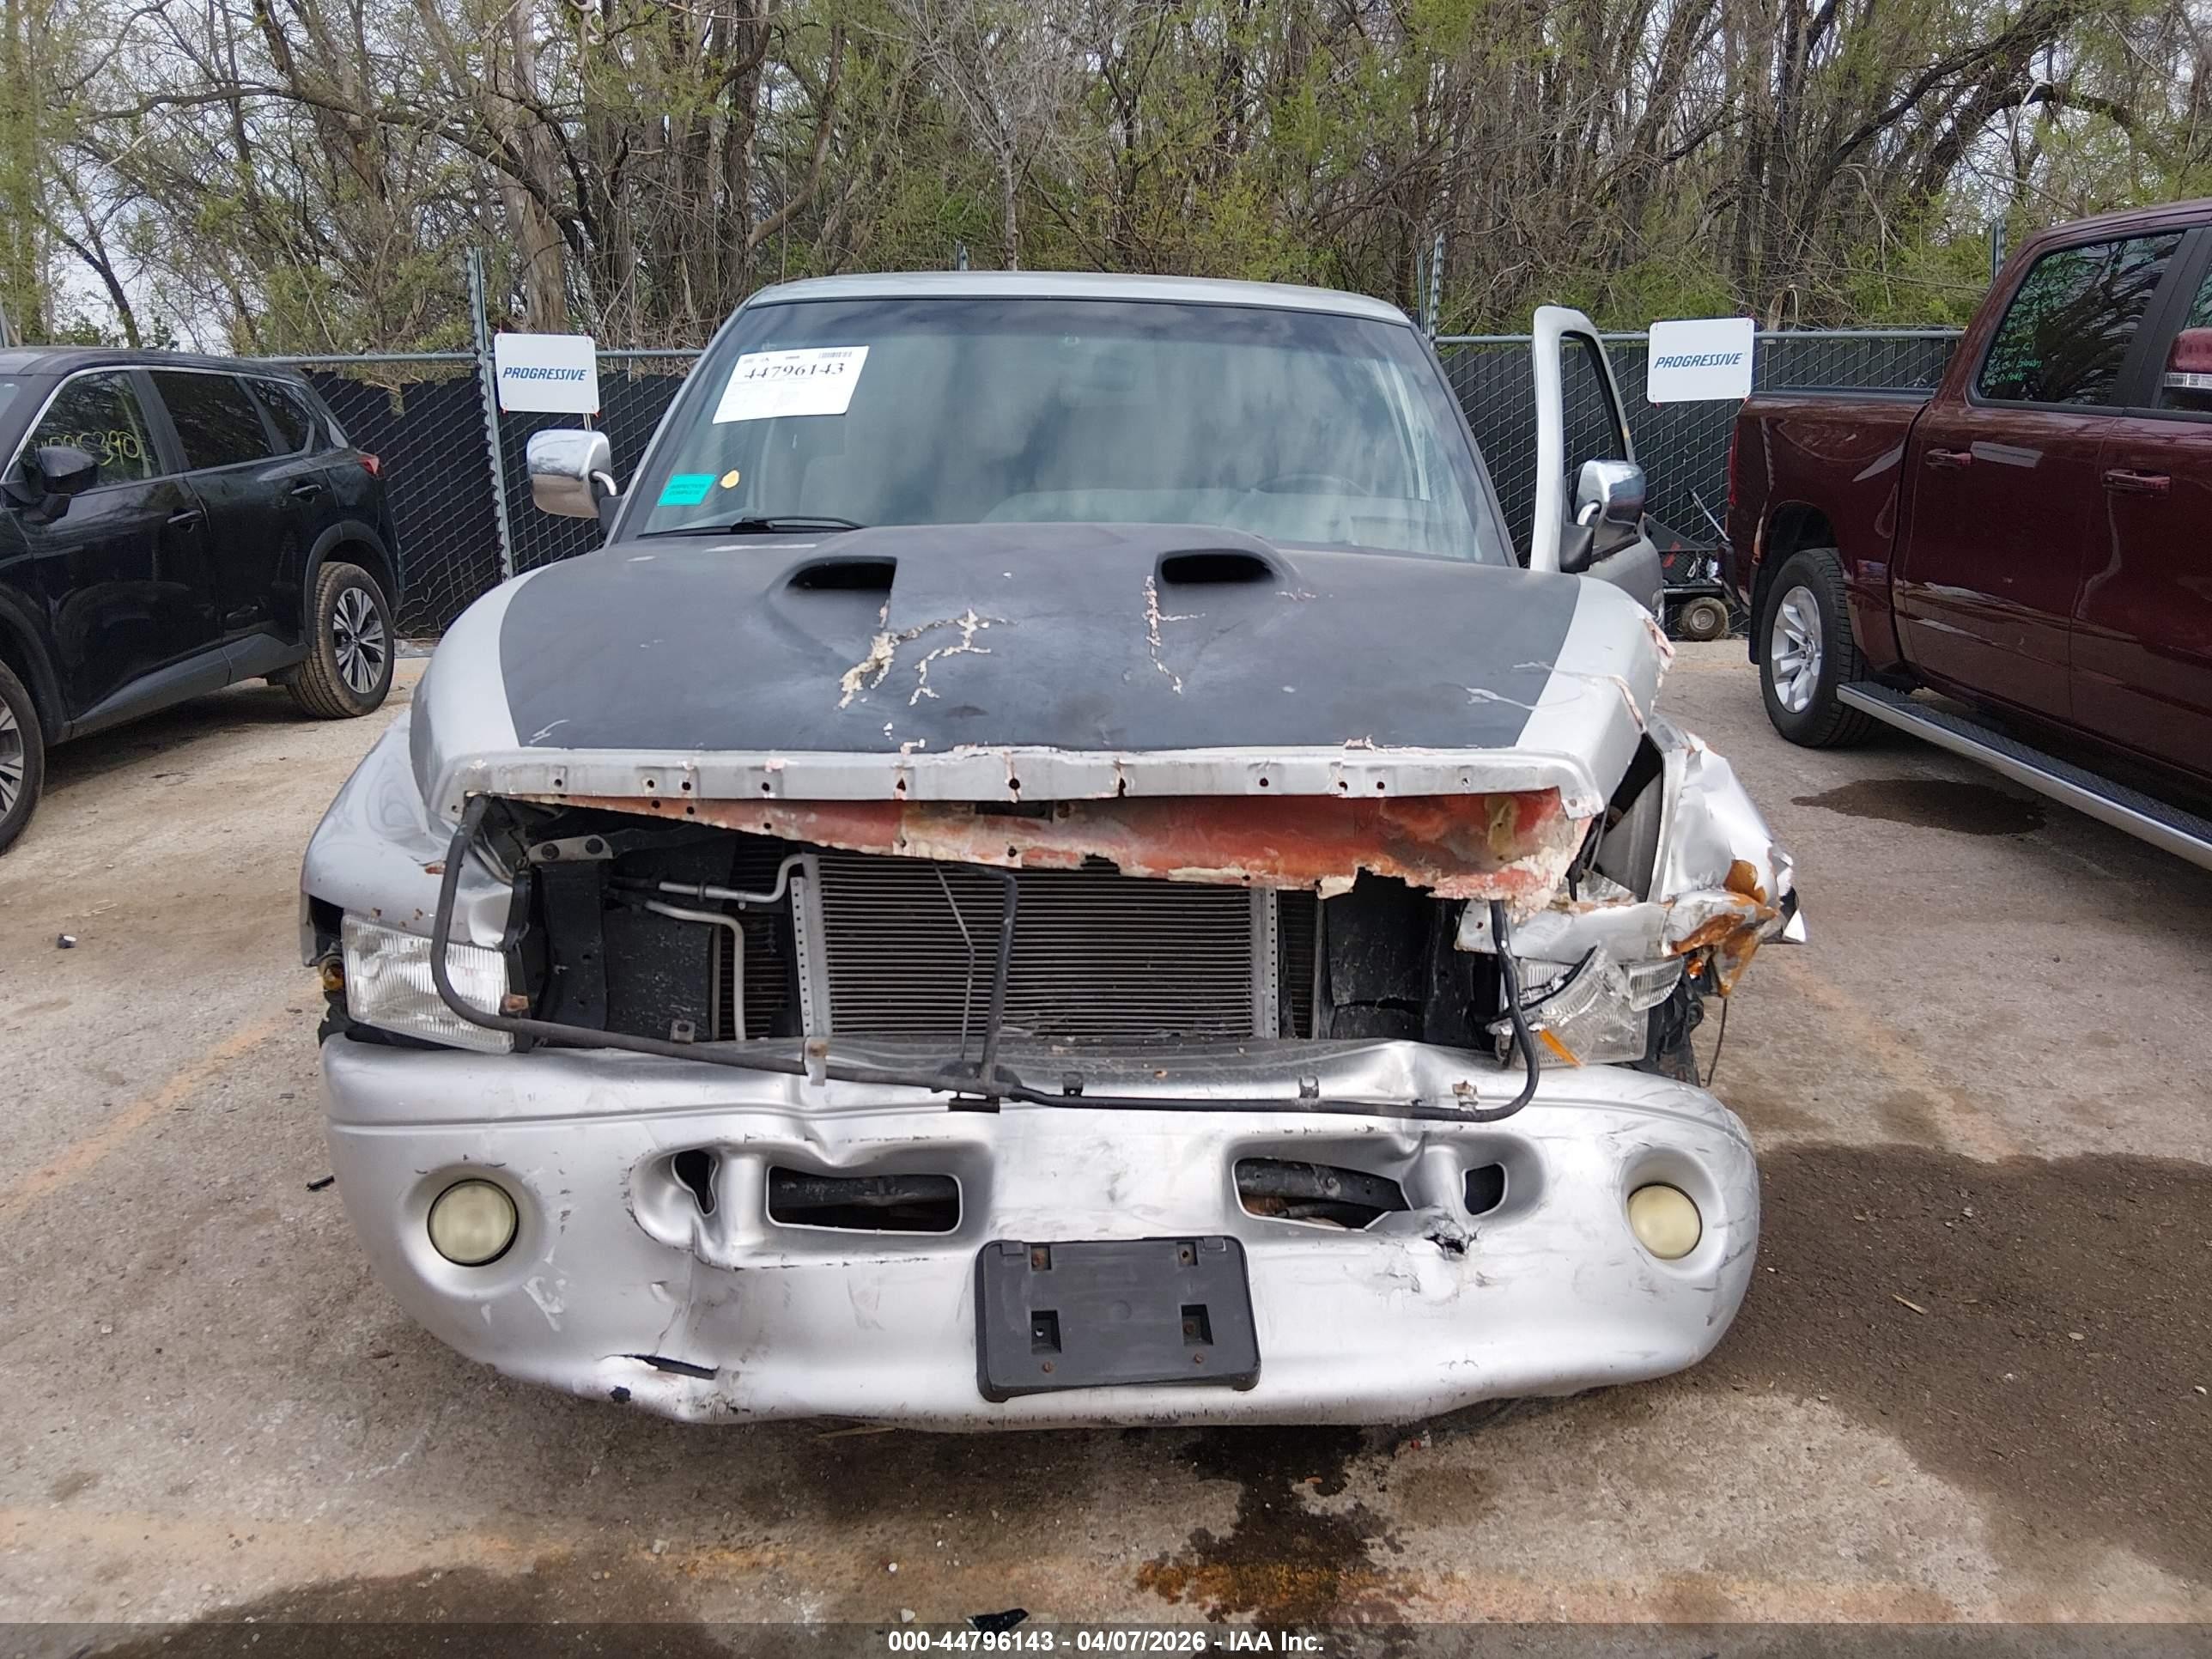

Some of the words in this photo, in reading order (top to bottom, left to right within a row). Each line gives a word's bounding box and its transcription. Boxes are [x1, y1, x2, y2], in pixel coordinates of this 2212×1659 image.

[1654, 352, 1743, 369] PROGRESSIVE
[502, 367, 587, 380] PROGRESSIVE
[744, 362, 846, 380] 44796143
